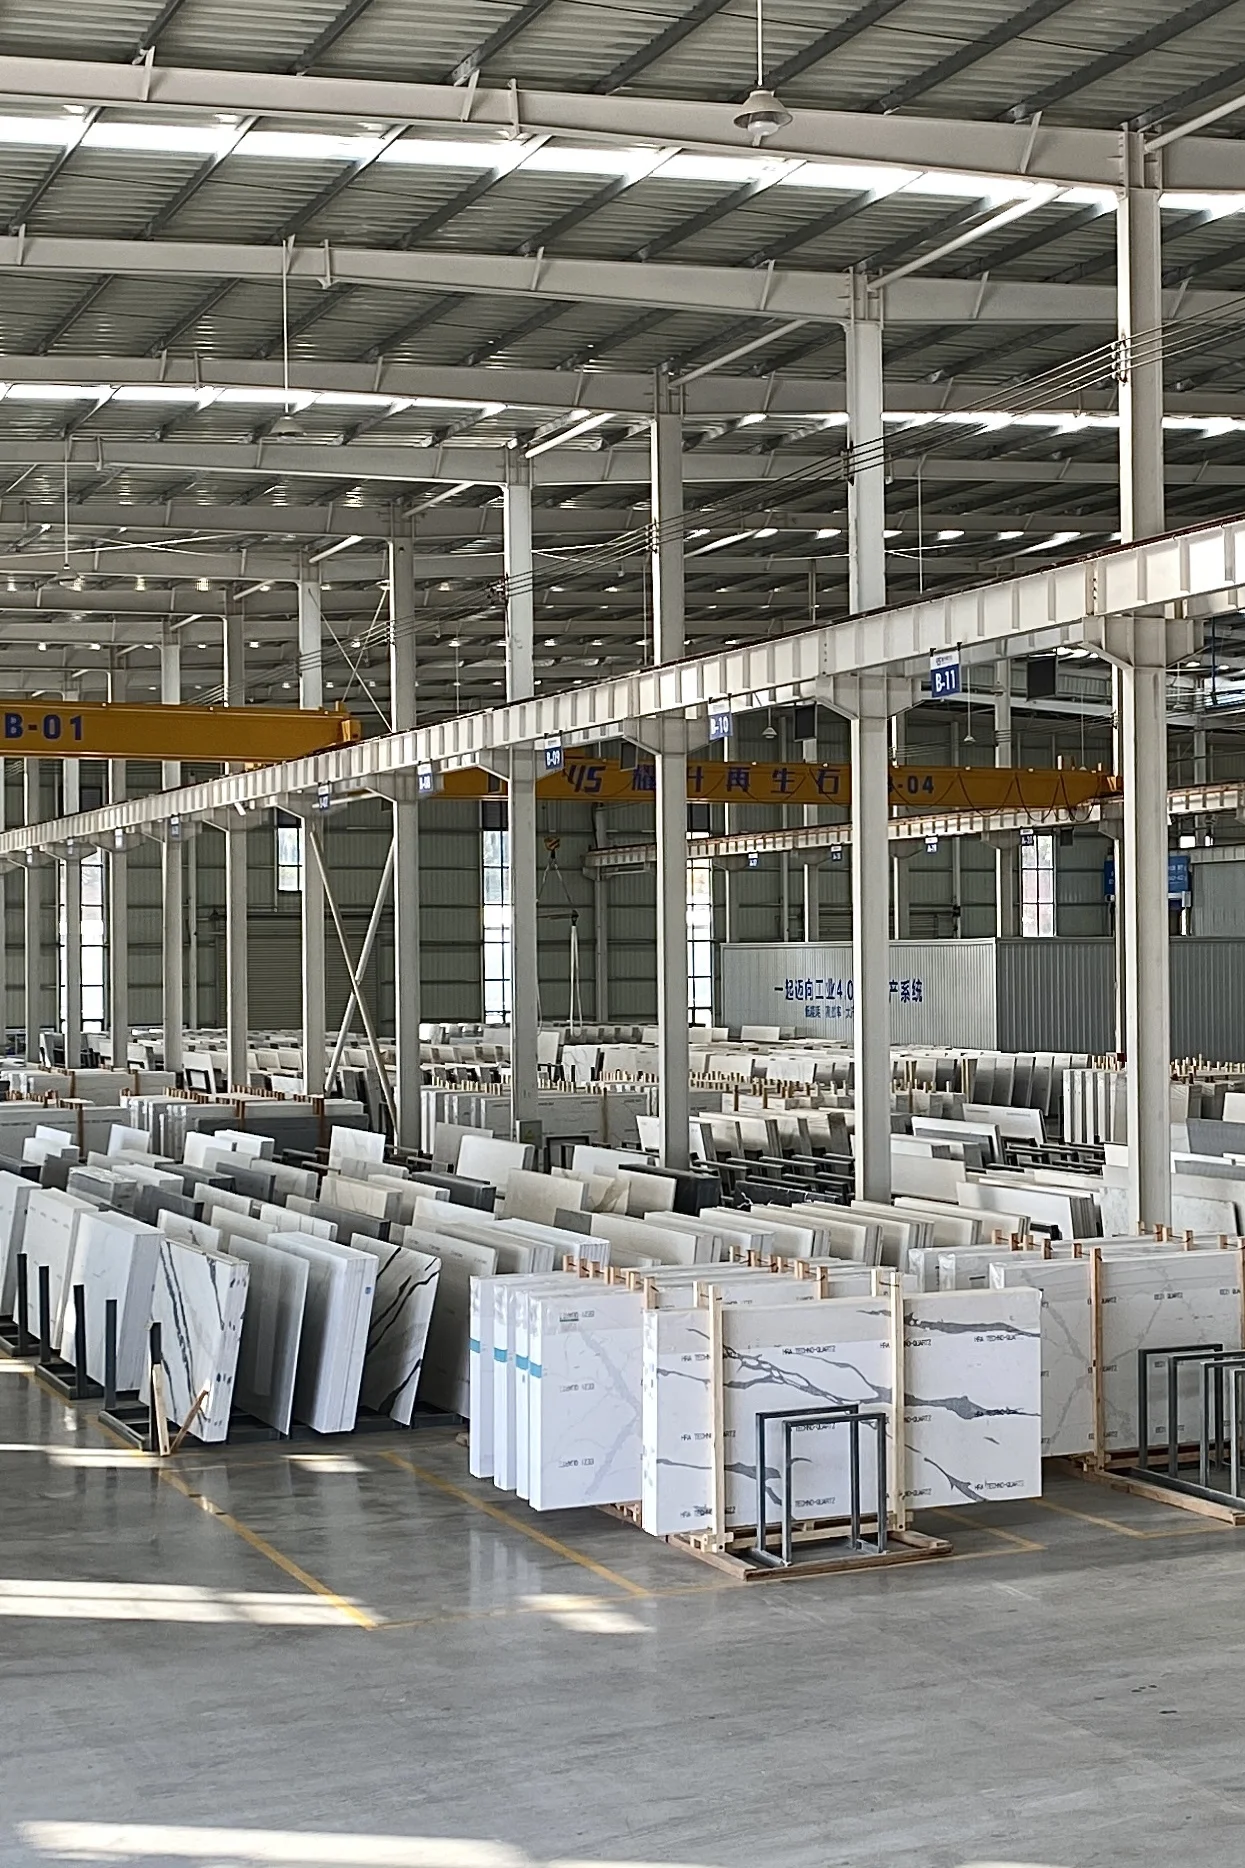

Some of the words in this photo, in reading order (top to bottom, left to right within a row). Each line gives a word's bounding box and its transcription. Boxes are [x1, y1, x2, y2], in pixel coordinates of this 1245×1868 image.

[935, 670, 955, 692] B-11
[5, 713, 83, 740] B-01
[710, 716, 729, 735] B-10
[546, 750, 560, 766] B-09
[889, 775, 934, 794] -04
